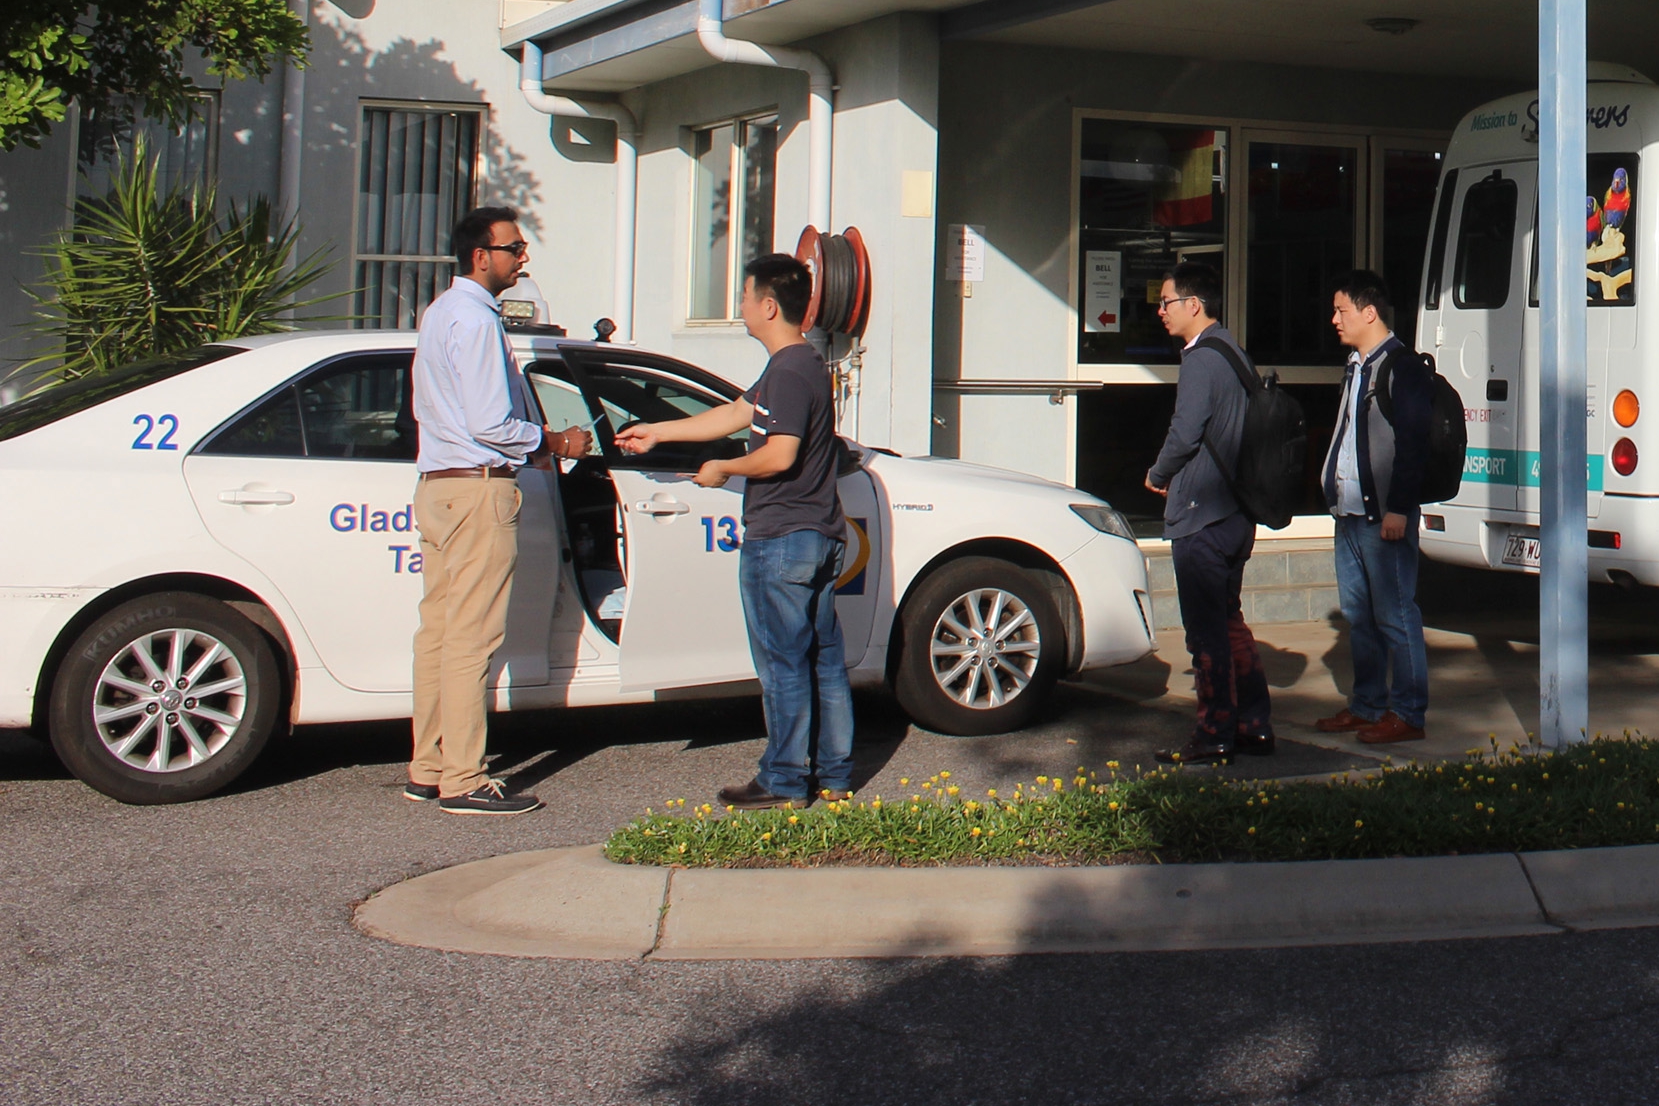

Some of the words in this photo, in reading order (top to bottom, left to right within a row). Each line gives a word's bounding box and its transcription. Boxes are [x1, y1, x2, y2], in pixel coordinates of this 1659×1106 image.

[1470, 111, 1505, 132] Mission
[1508, 110, 1518, 126] to
[1095, 264, 1111, 272] BELL
[1480, 408, 1492, 422] EXIT
[132, 413, 179, 450] 22
[1463, 455, 1506, 476] NSPORT
[329, 503, 418, 532] Glad
[892, 503, 934, 512] HYBRID
[86, 605, 175, 659] KUMHO
